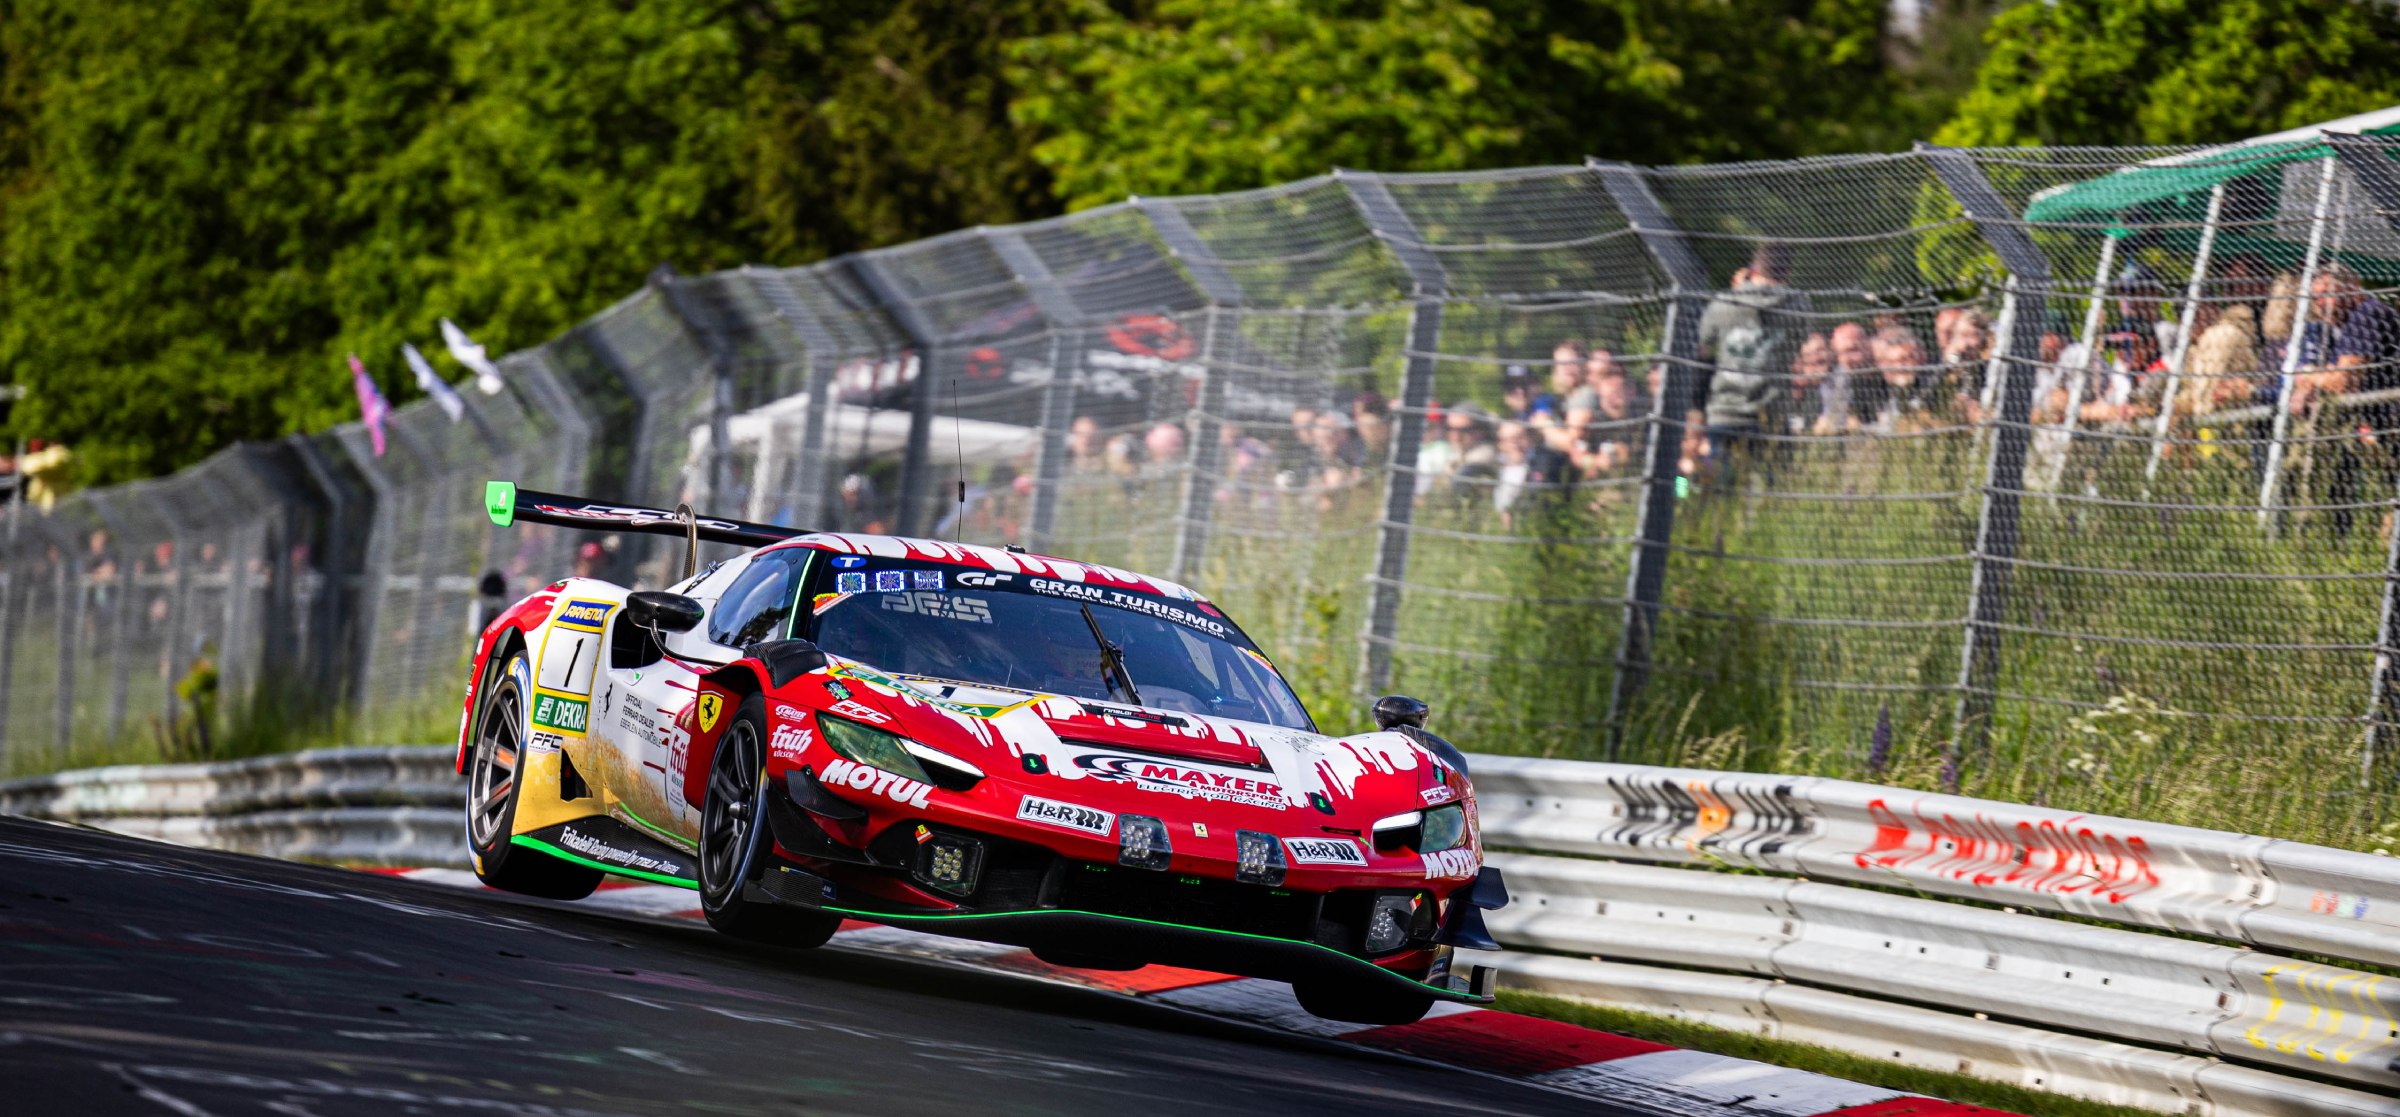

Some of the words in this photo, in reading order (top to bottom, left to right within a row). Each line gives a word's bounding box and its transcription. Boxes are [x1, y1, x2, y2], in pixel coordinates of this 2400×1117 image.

[1029, 578, 1103, 598] GRAN
[1111, 591, 1224, 633] TURISMO
[1033, 588, 1060, 596] THE
[1063, 592, 1097, 602] REAL
[1100, 598, 1152, 614] DRIVING
[1154, 611, 1226, 640] SIMULATOR
[563, 637, 585, 688] 1
[940, 685, 958, 699] 1
[553, 700, 587, 730] DEKRA
[819, 758, 935, 809] MOTUL
[1141, 765, 1283, 797] MAYER
[1200, 784, 1284, 803] MOTORSPORT
[1420, 785, 1451, 800] PFC
[1233, 796, 1286, 810] RACING
